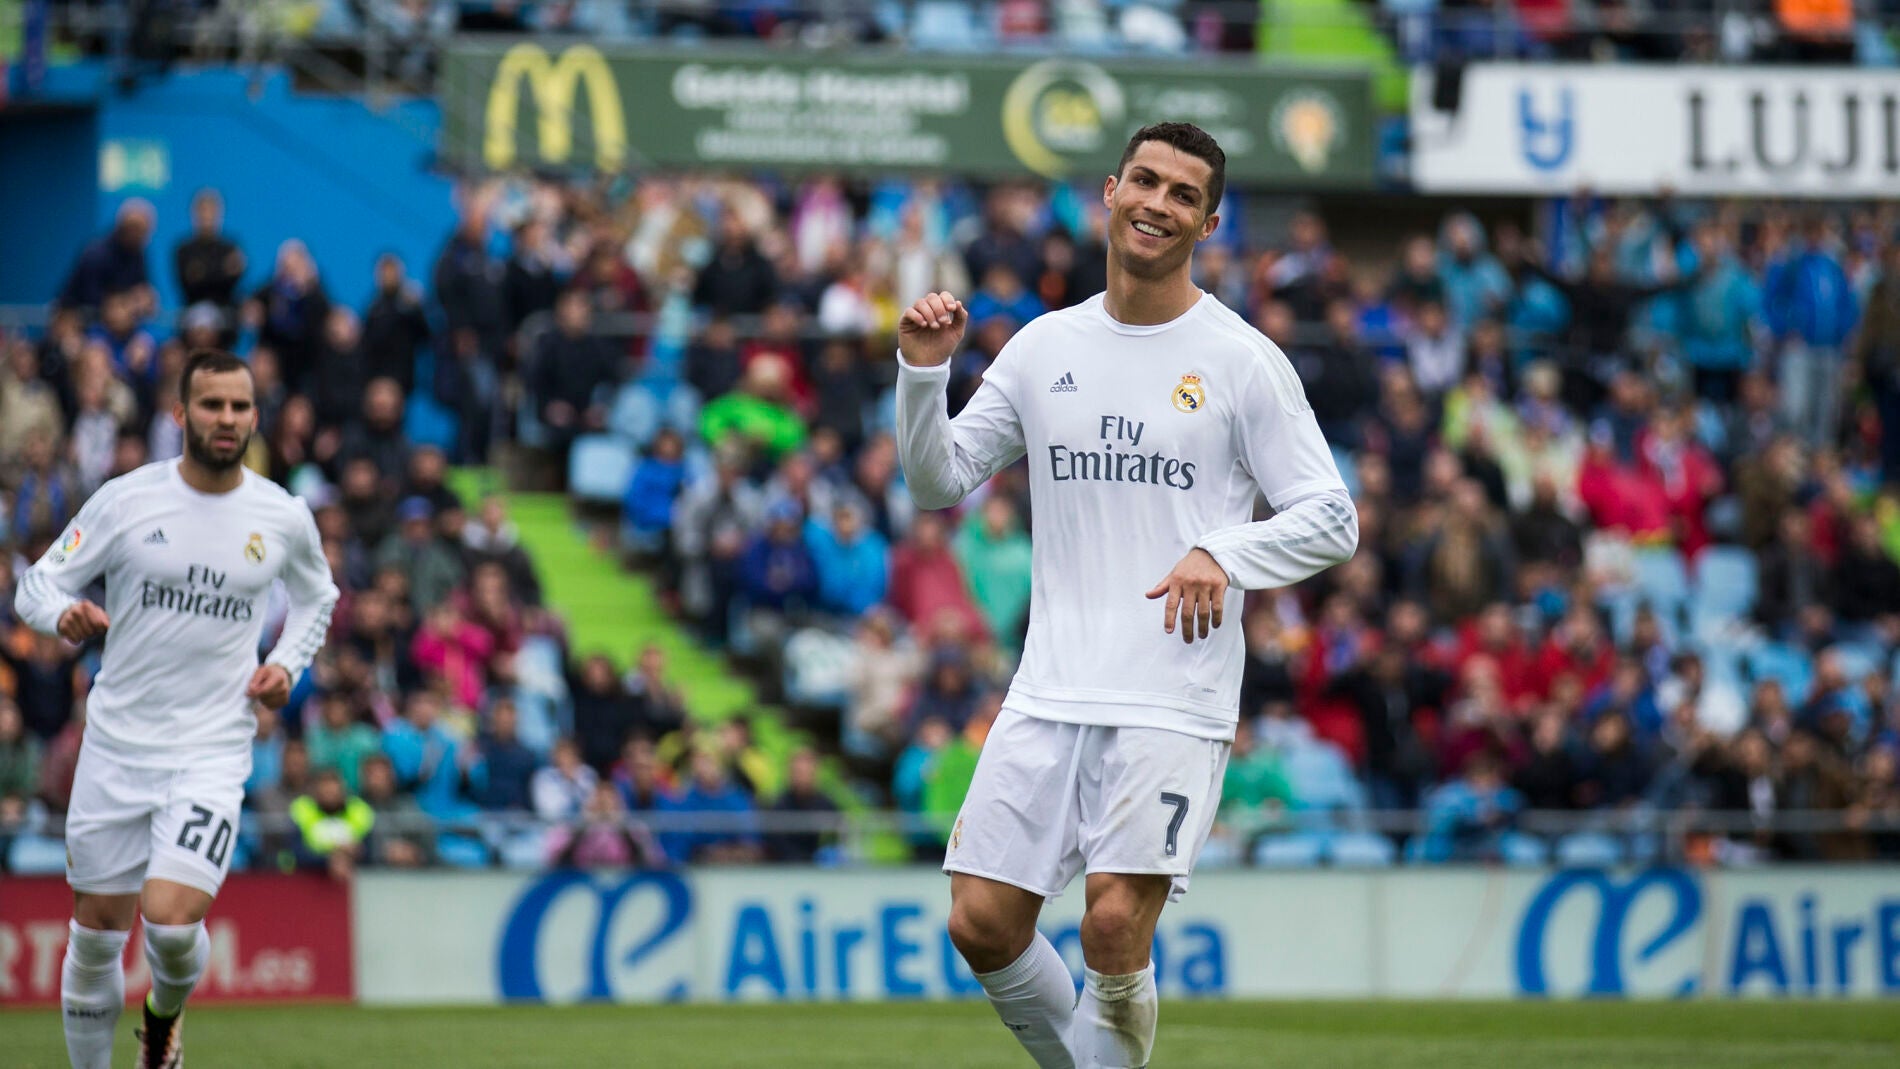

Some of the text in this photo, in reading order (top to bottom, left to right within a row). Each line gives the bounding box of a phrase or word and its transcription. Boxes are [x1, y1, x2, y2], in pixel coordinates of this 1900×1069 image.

[1050, 384, 1078, 393] adidas
[1100, 415, 1145, 447] Fly
[1048, 444, 1196, 490] Emirates
[142, 580, 253, 622] Emirates
[176, 804, 232, 869] 20
[1160, 791, 1190, 856] 7
